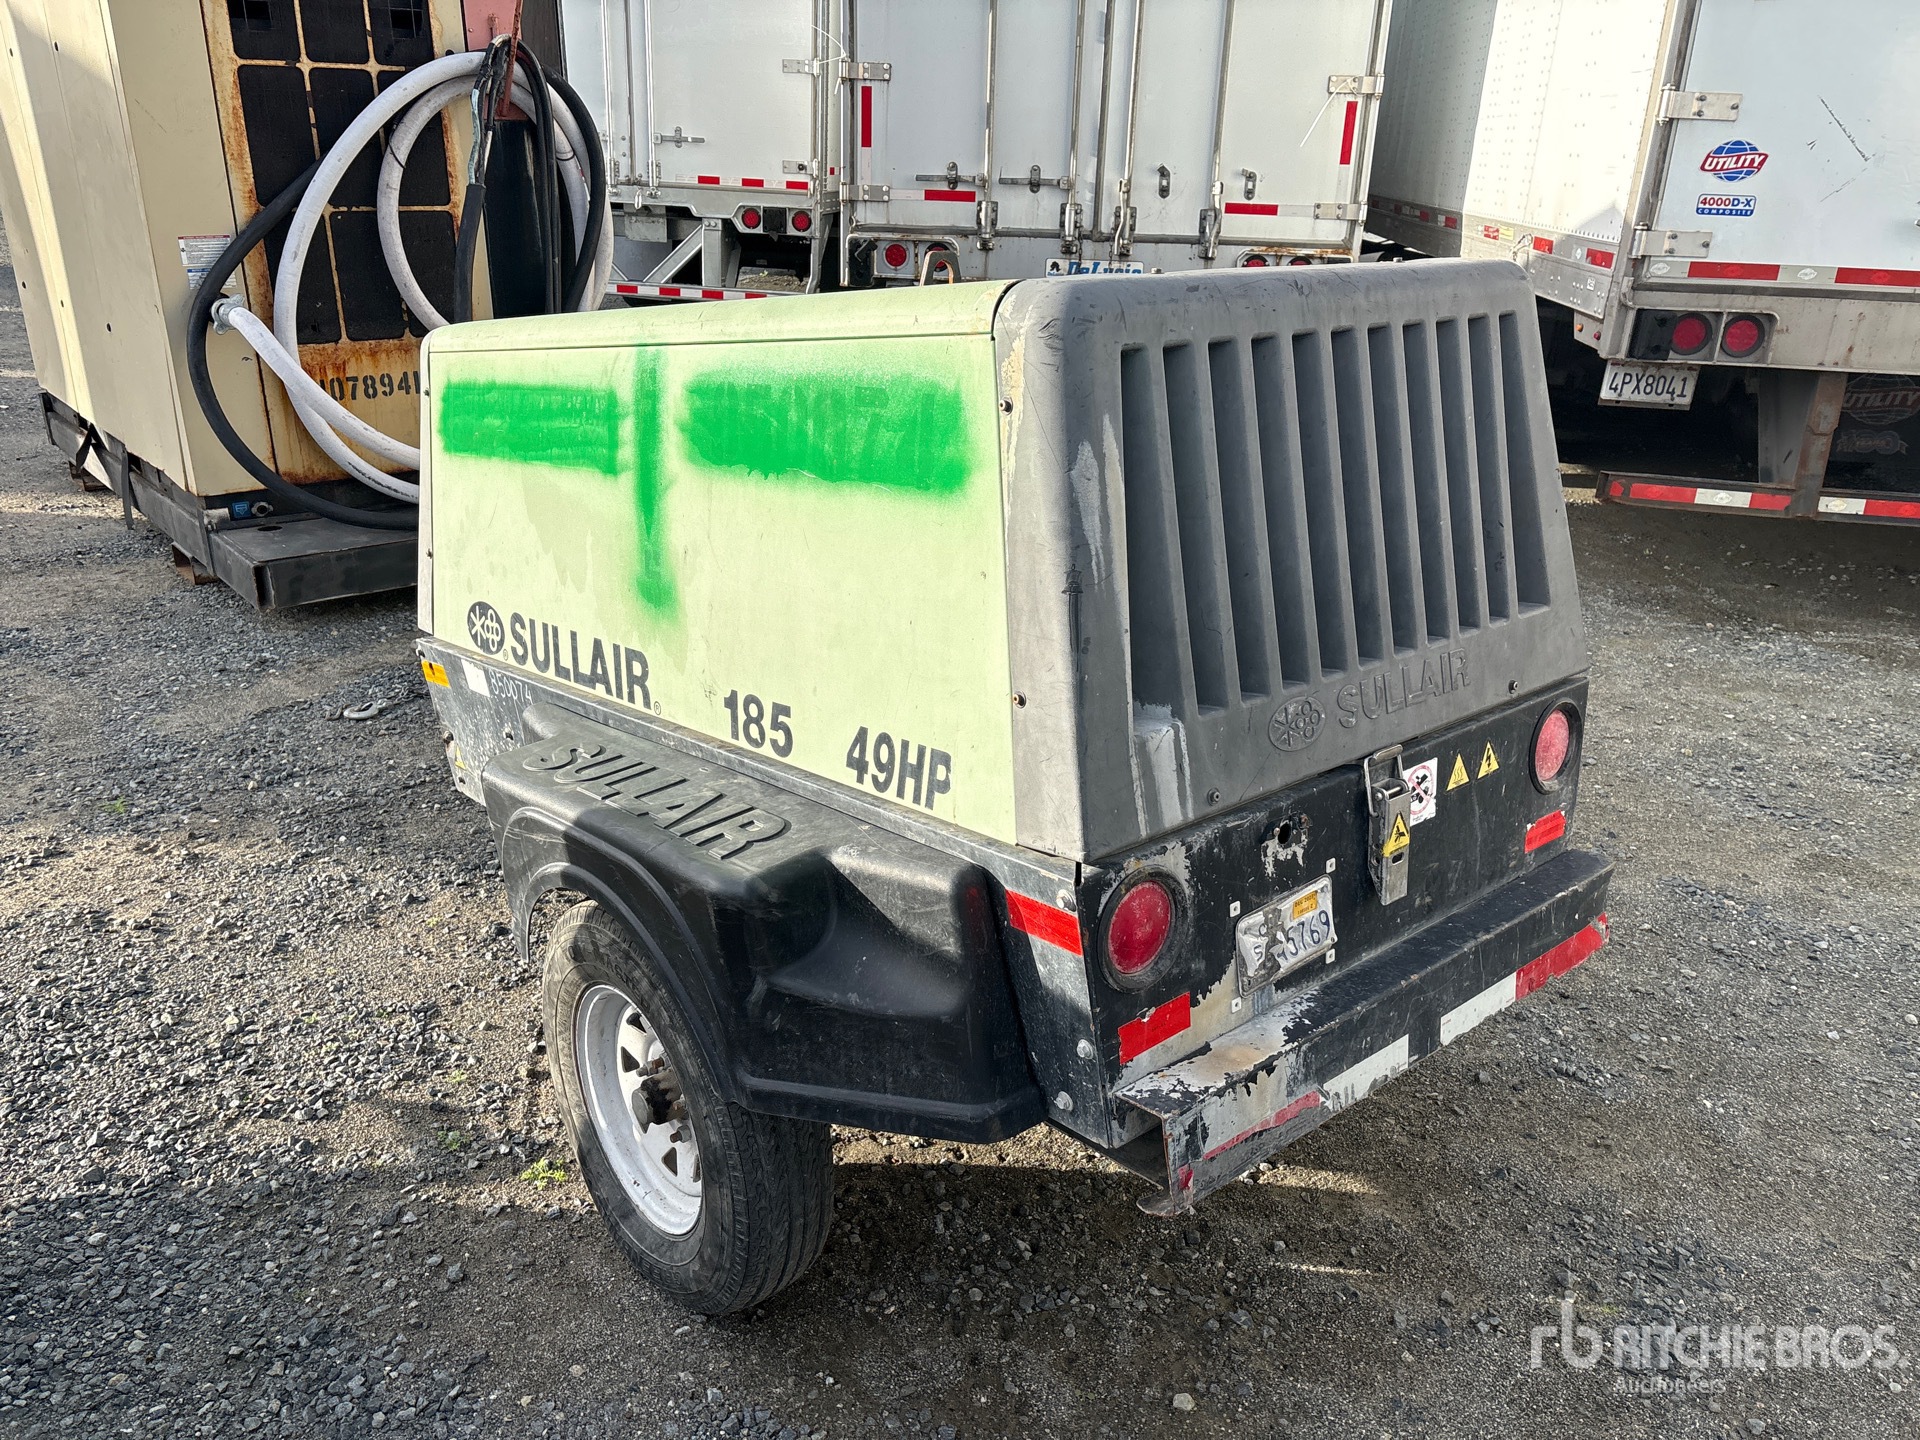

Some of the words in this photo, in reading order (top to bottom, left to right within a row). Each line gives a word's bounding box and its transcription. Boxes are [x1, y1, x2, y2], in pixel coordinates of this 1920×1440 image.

[1704, 154, 1765, 170] UTILITY
[1697, 208, 1752, 216] COMPOSITE
[1700, 196, 1754, 208] 4000D-X
[1608, 371, 1688, 398] 4PX8041
[510, 612, 652, 710] SULLAIR
[1337, 648, 1470, 728] SULLAIR
[724, 689, 793, 758] 185
[846, 726, 952, 811] 49HP
[523, 744, 793, 860] SULLAIR
